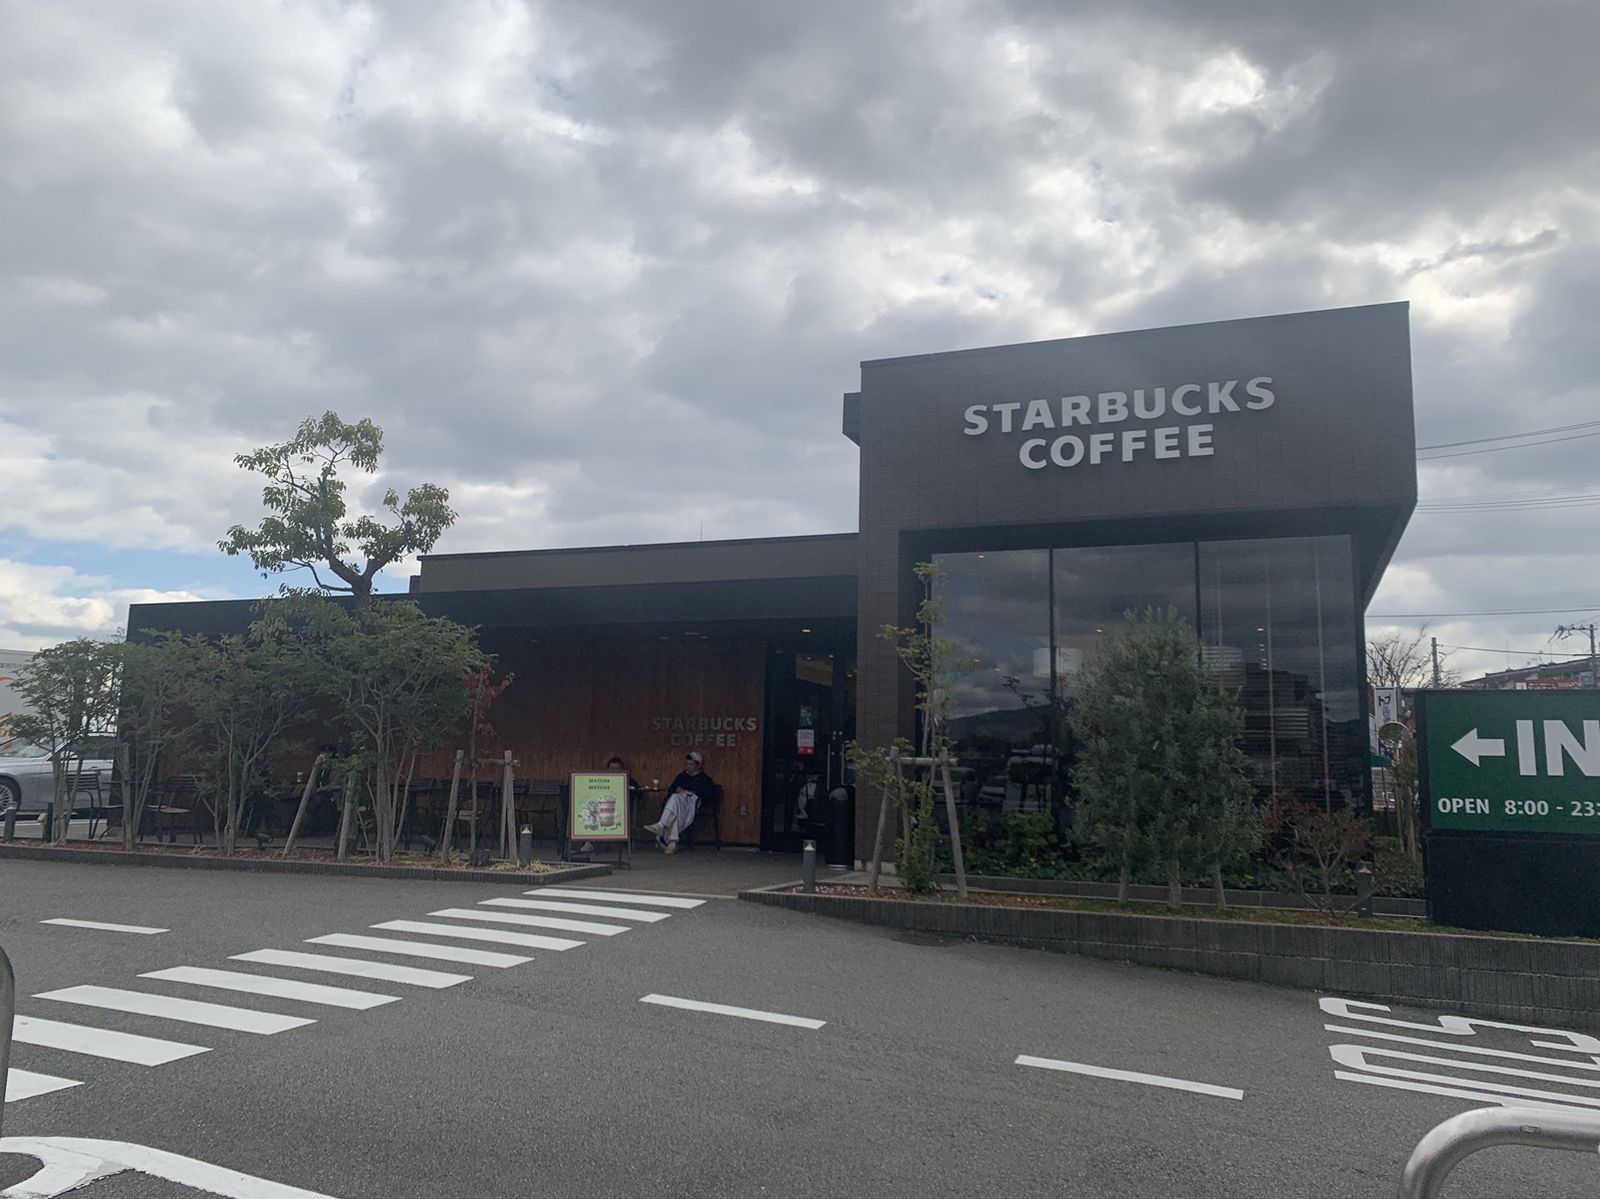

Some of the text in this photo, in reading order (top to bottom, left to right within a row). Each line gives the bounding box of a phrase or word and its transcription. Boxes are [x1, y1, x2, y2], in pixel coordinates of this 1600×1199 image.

[963, 376, 1276, 436] STARBUCKS
[1019, 423, 1215, 470] COFFEE
[651, 717, 758, 732] STARBUCKS
[671, 733, 737, 748] COFFEE
[1515, 719, 1600, 777] IN
[1437, 797, 1491, 815] OPEN
[1504, 799, 1549, 817] 8:00
